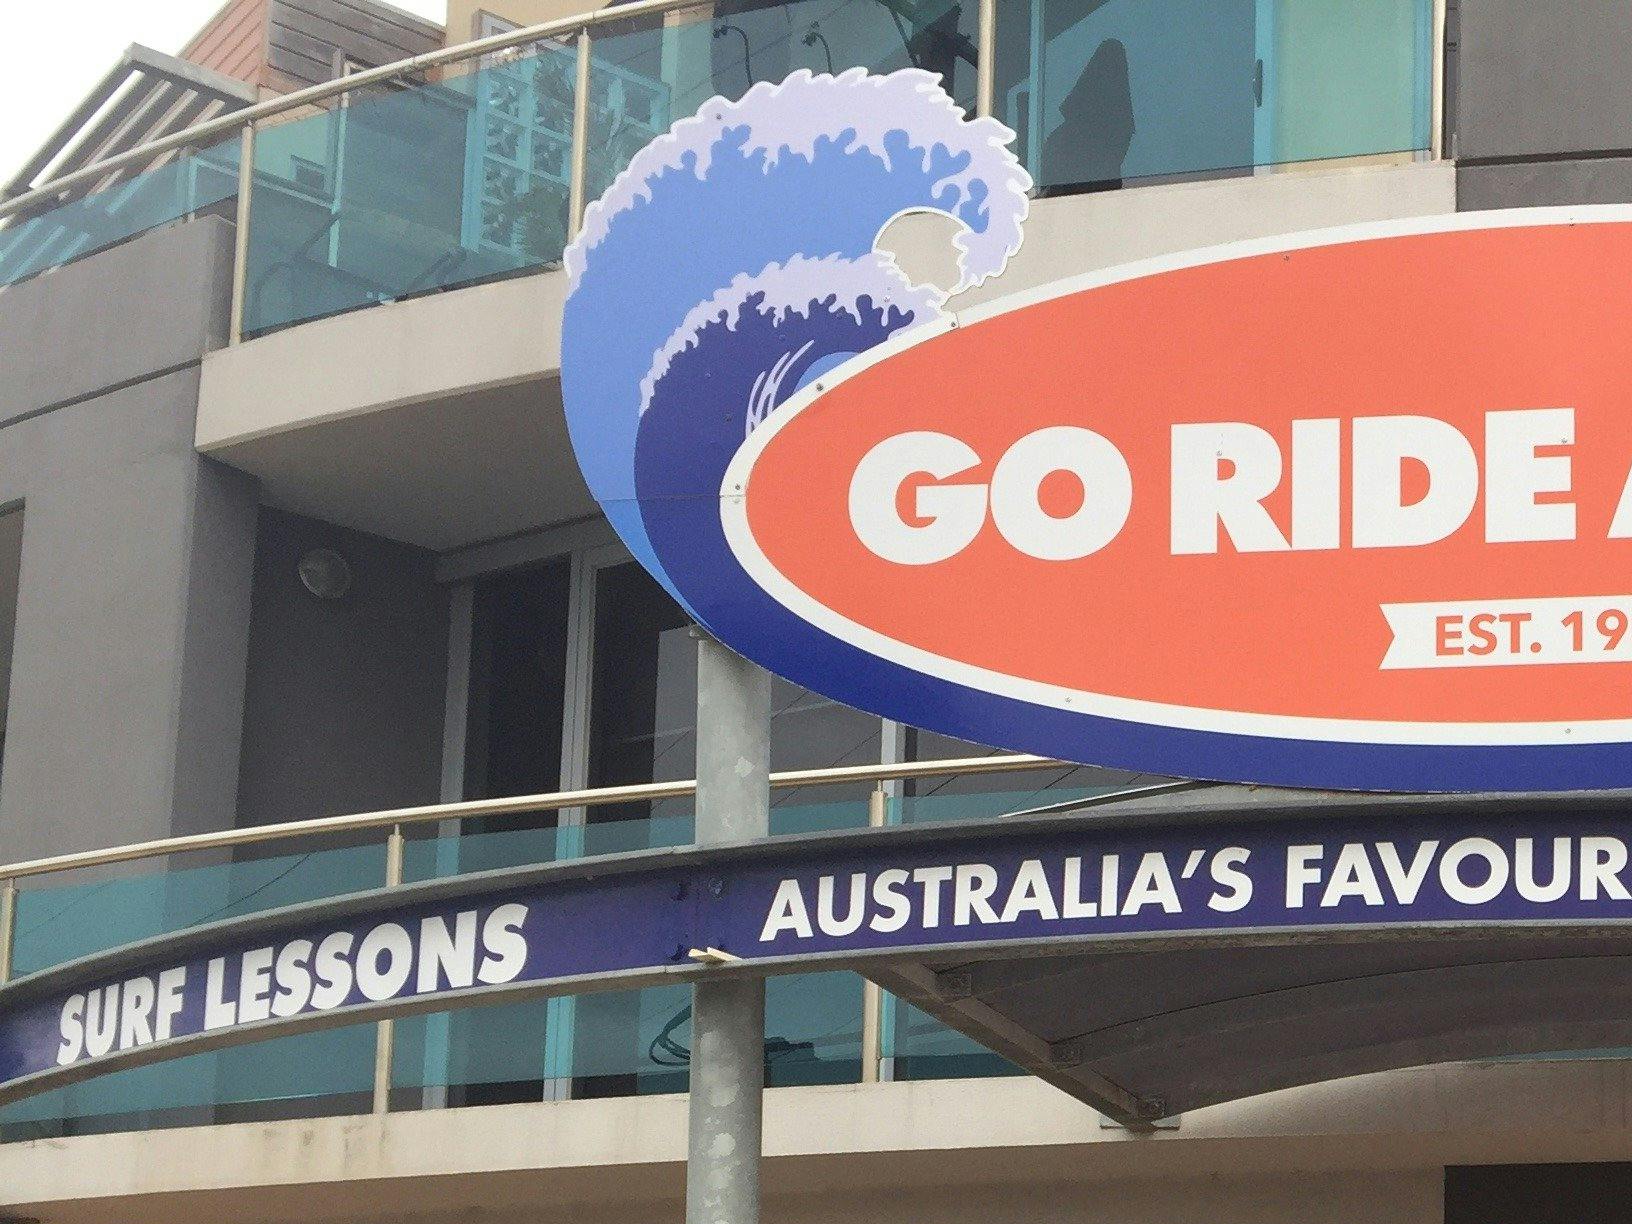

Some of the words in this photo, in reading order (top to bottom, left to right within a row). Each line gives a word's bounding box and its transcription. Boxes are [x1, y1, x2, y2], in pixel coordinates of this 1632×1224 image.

[849, 426, 1132, 565] GO
[1171, 408, 1576, 554] RIDE
[1436, 613, 1542, 656] EST.
[760, 848, 1252, 943] AUSTRALIA'S
[56, 965, 189, 1073] SURF
[203, 903, 528, 1031] LESSONS
